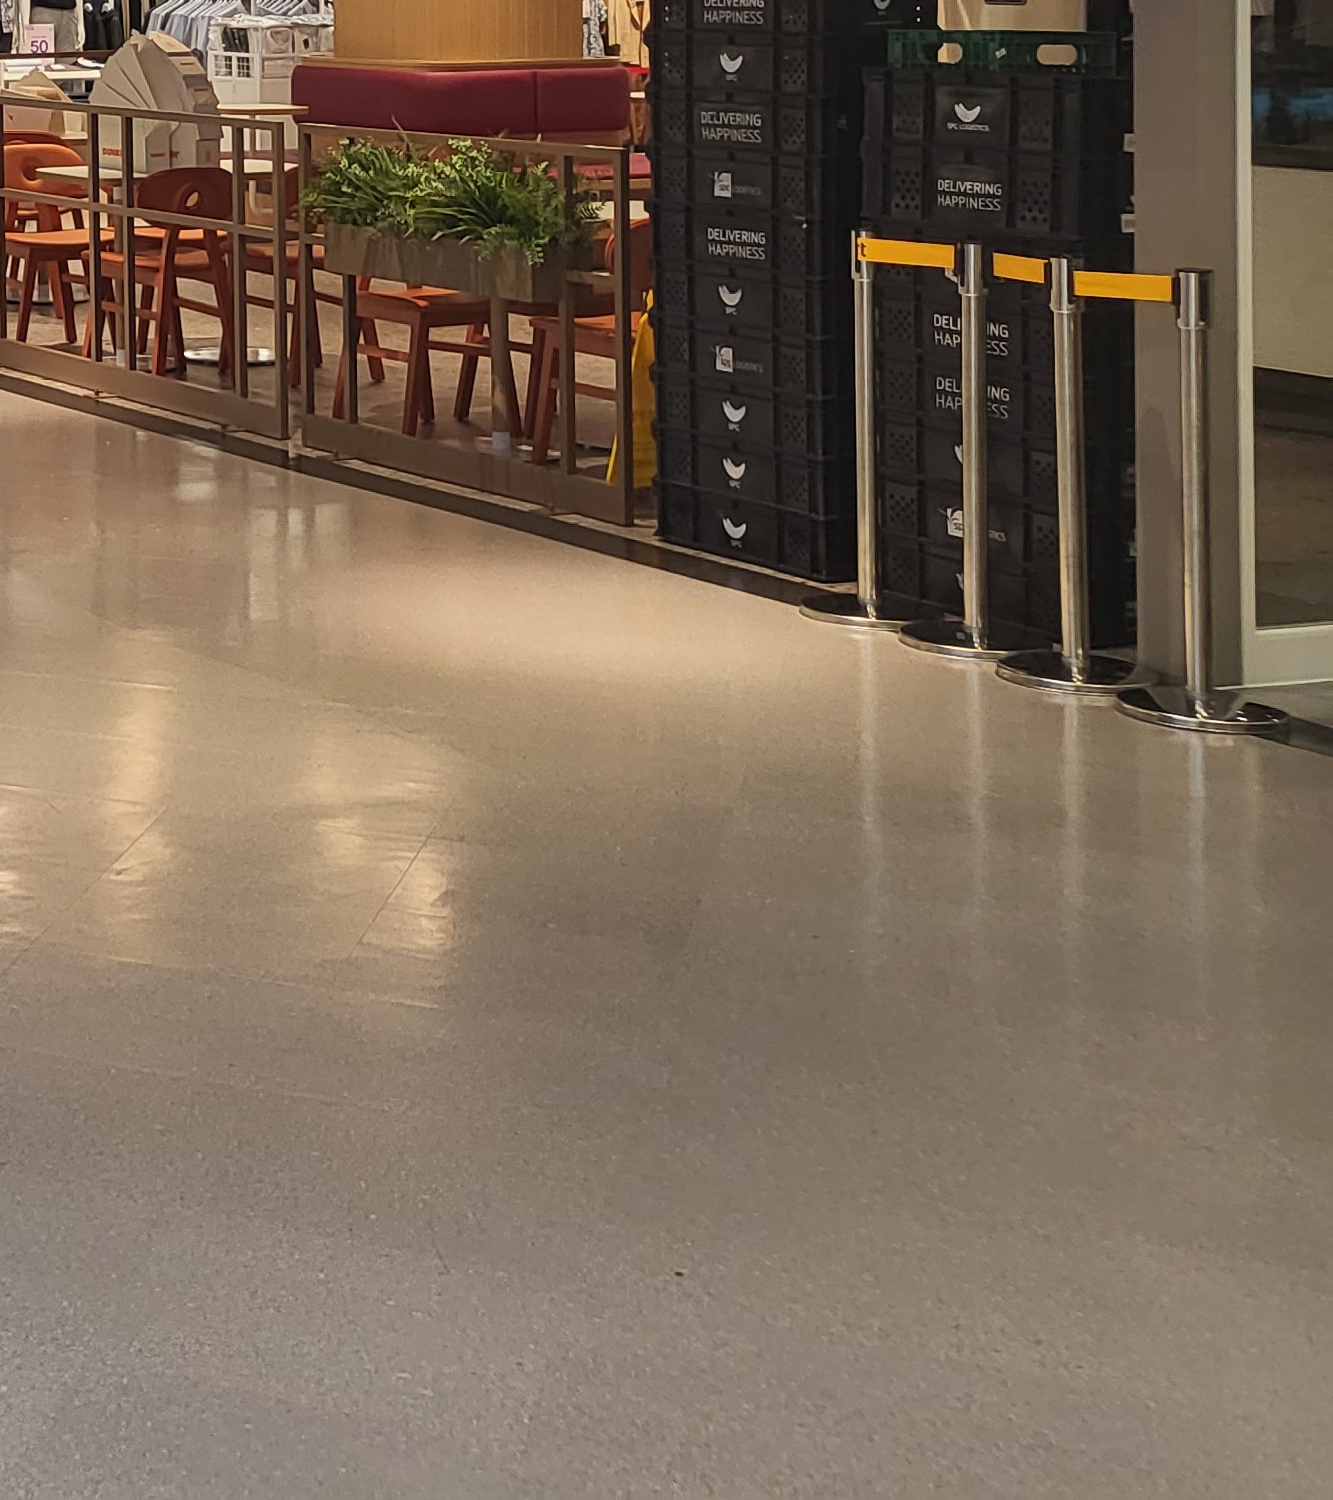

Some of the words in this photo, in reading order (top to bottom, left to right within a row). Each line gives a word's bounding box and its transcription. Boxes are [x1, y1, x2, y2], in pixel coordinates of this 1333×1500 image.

[703, 11, 764, 25] HAPPINESS
[30, 40, 49, 54] 50
[700, 111, 762, 127] DELIVERING
[701, 127, 762, 143] HAPPINESS
[937, 179, 1002, 196] DELIVERING
[937, 194, 1001, 211] HAPPINESS
[707, 228, 766, 244] DELIVERING
[708, 243, 766, 260] HAPPINESS
[933, 313, 1009, 338] DELIING
[936, 376, 1010, 402] DELING
